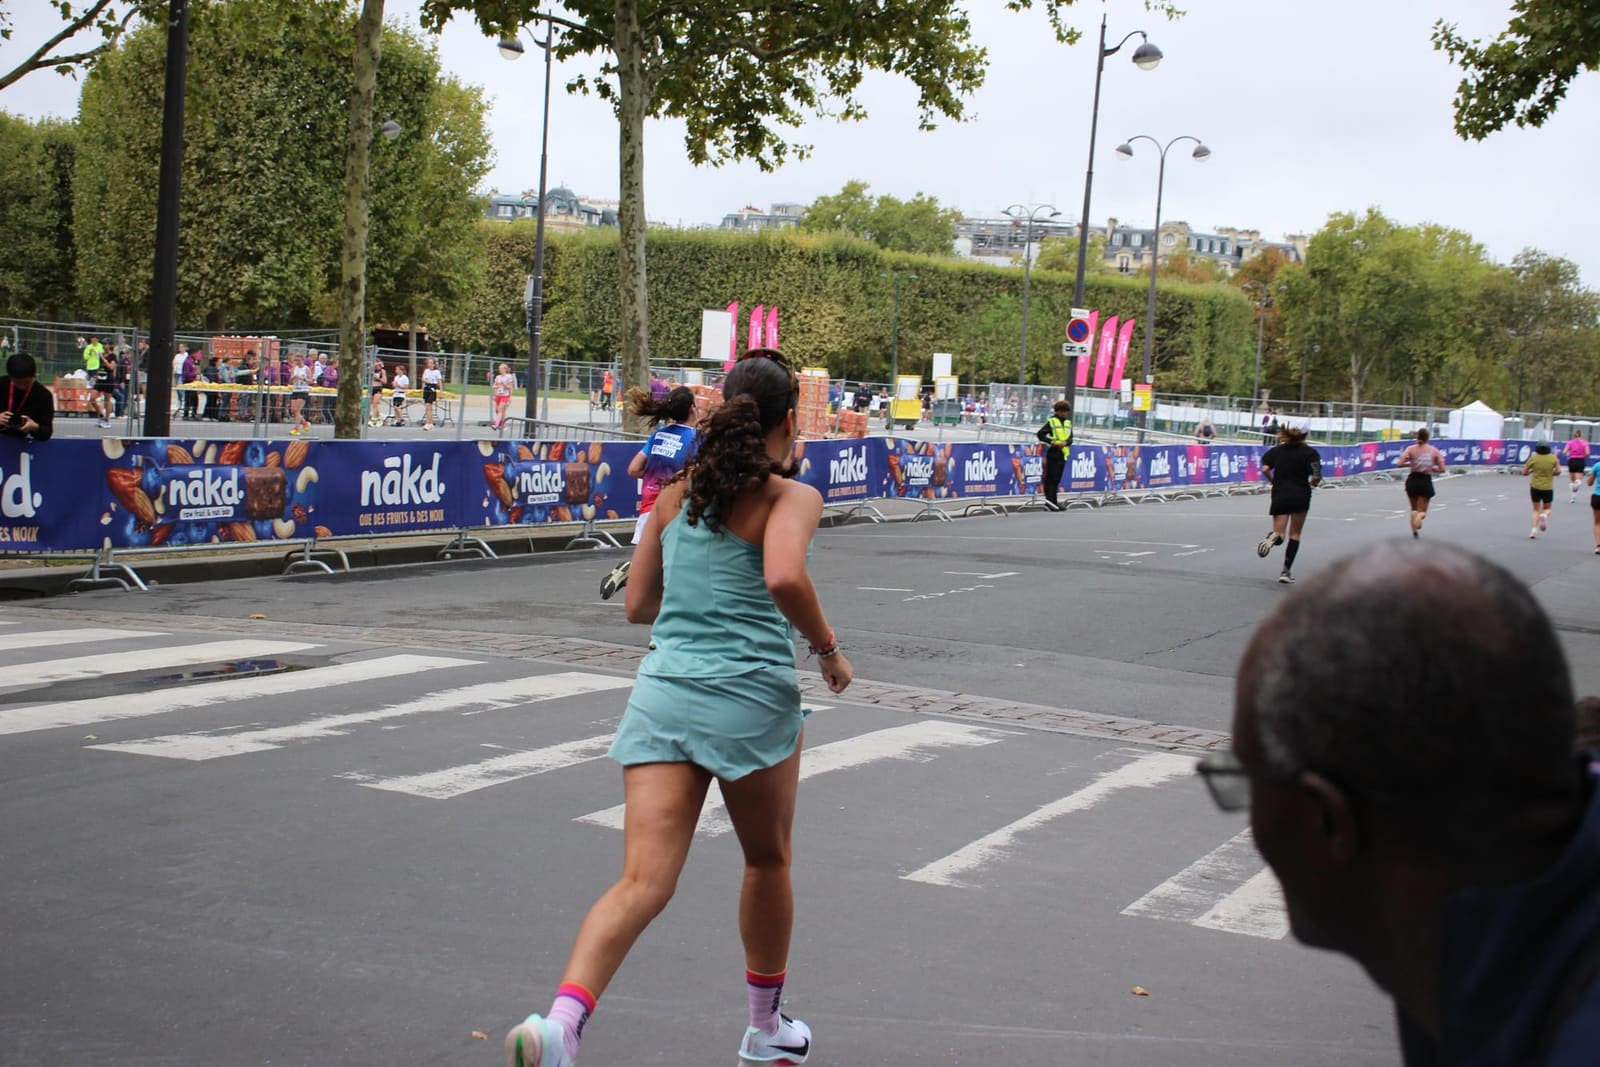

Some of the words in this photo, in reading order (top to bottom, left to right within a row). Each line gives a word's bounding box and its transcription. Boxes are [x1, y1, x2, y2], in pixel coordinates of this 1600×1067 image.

[0, 452, 42, 518] d.
[361, 452, 445, 506] nākd.
[12, 526, 40, 542] NOIX
[373, 512, 385, 525] DES
[386, 511, 408, 524] FRUITS
[410, 510, 416, 523] &
[416, 510, 428, 522] DES
